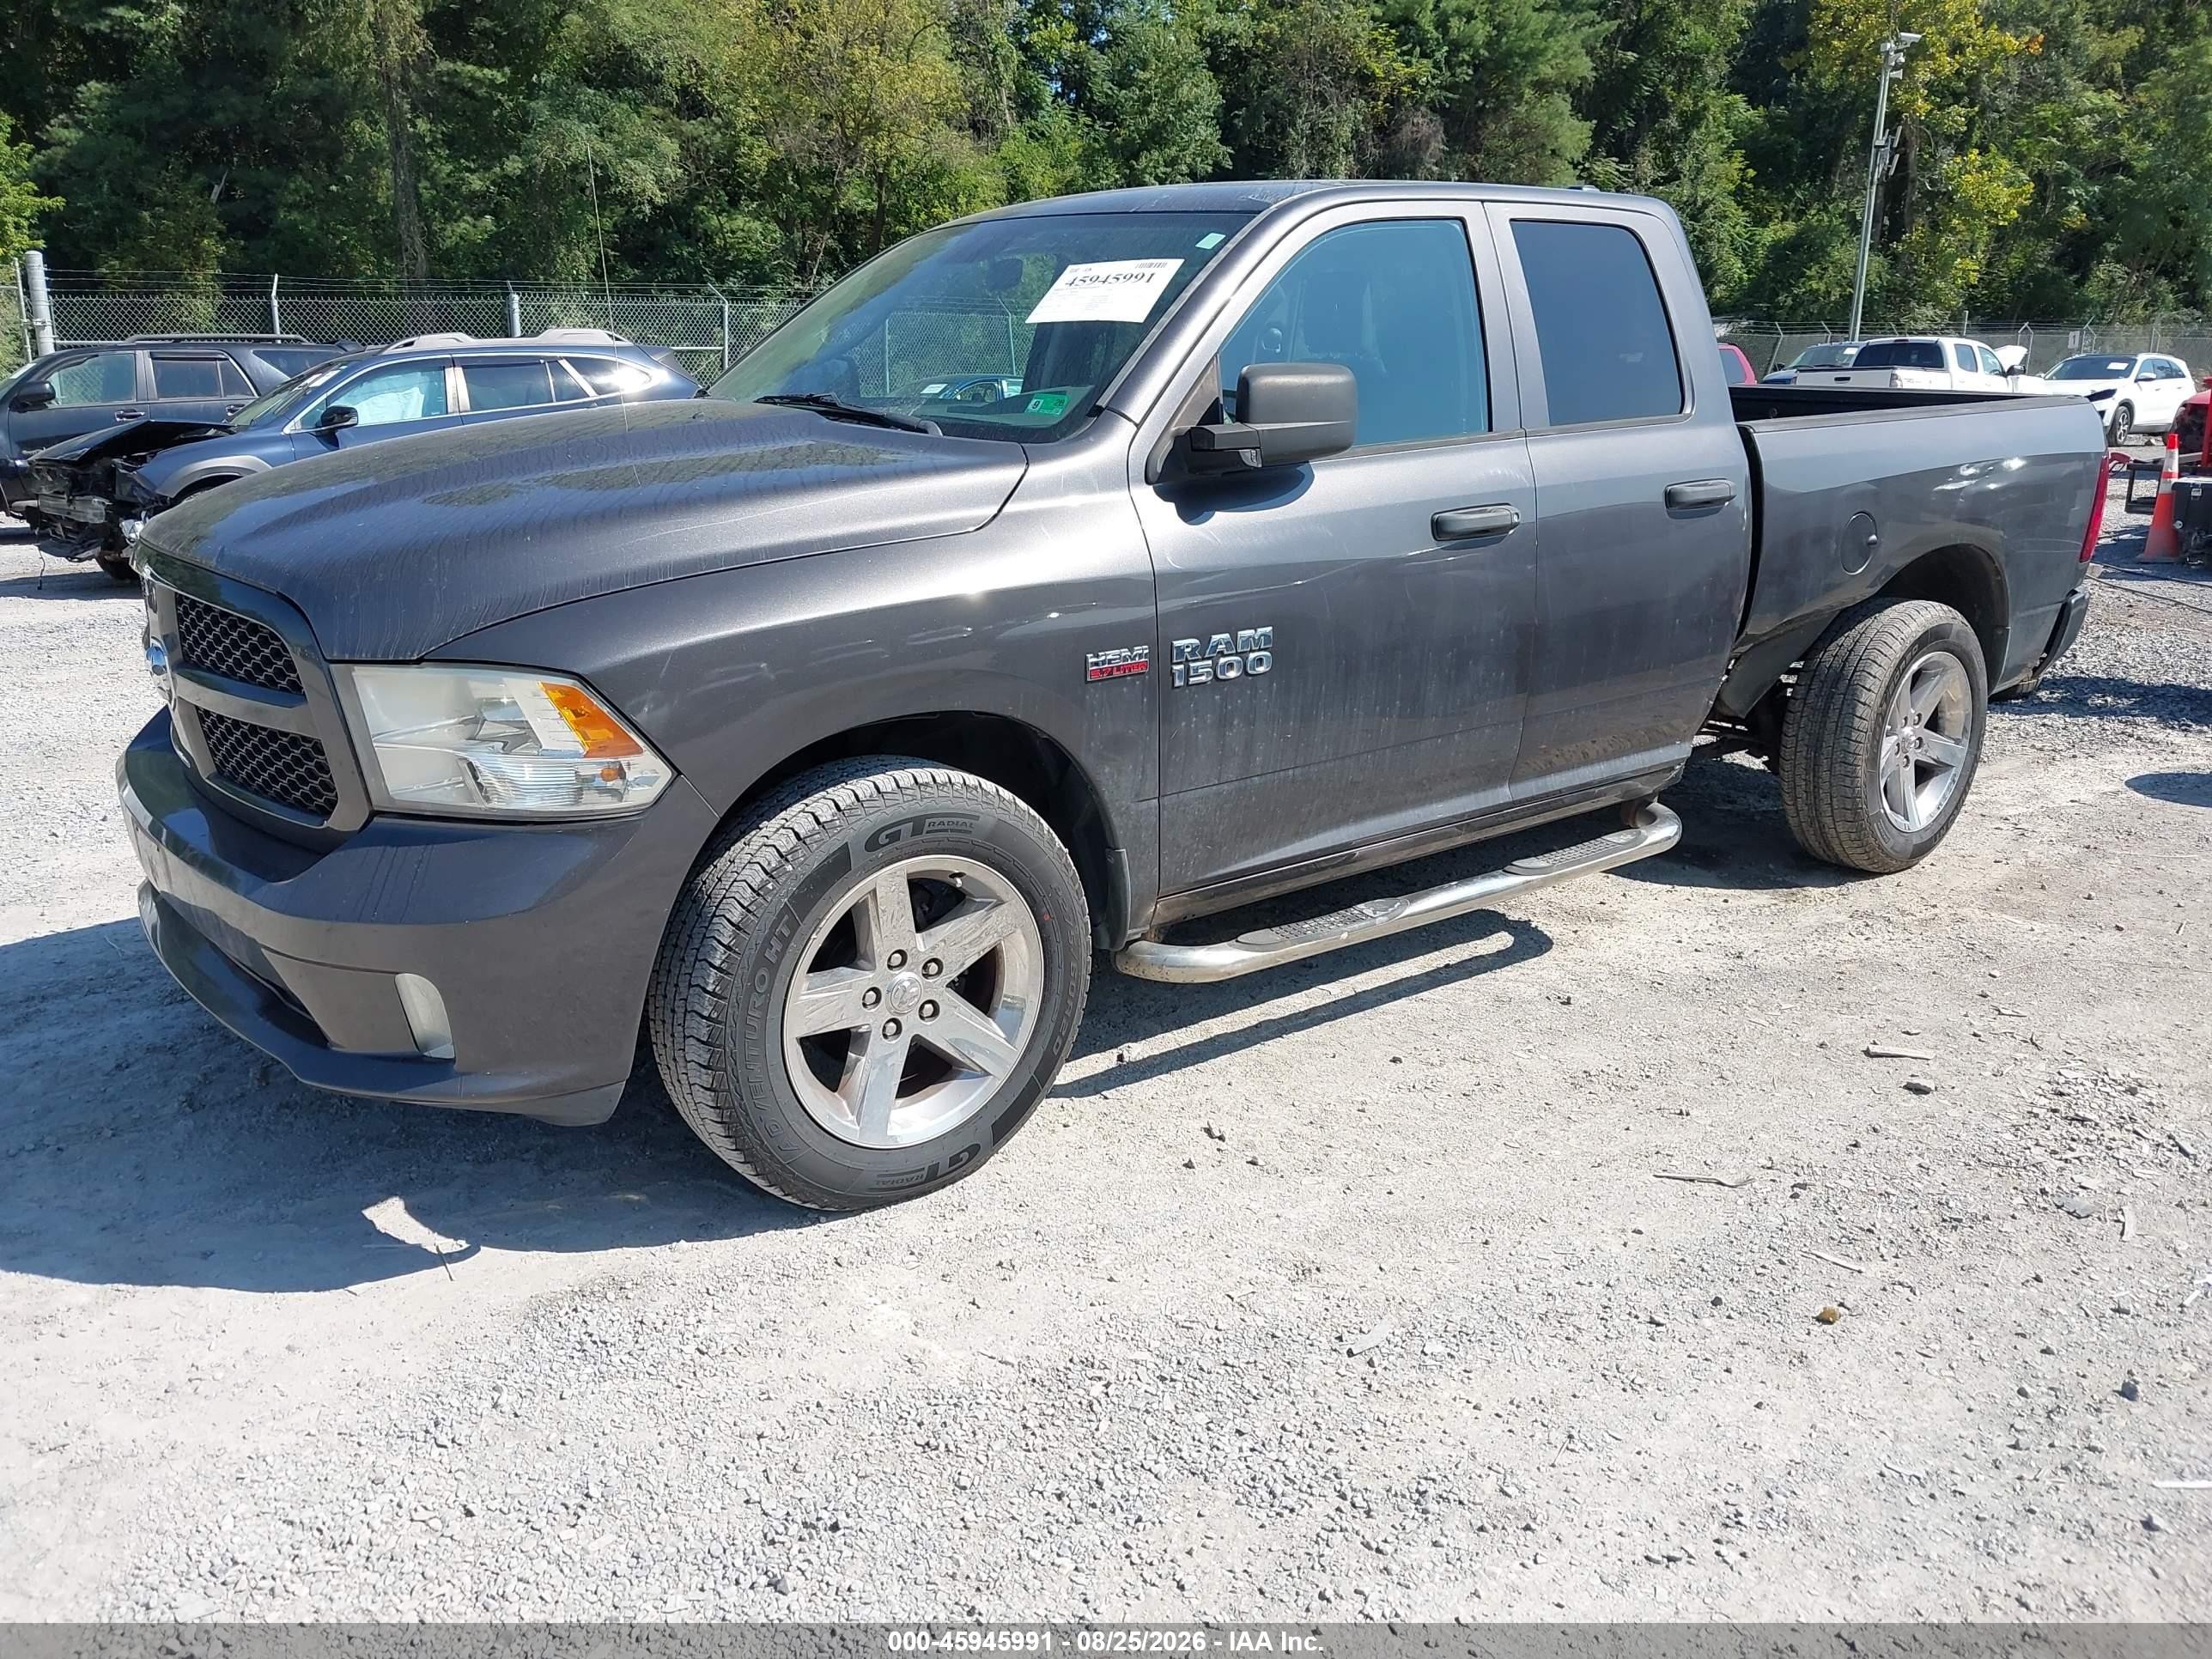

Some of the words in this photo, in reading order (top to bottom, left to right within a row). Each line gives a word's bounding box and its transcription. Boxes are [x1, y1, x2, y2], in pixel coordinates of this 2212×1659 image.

[1065, 272, 1156, 287] 45945991
[1086, 645, 1149, 668] HEMI
[1171, 626, 1273, 663] RAM
[1090, 667, 1111, 679] 5.7
[1113, 661, 1147, 676] LITER
[1171, 651, 1273, 688] 1500
[865, 813, 945, 852] GT
[927, 819, 976, 829] RADIAL
[764, 914, 791, 963] HT
